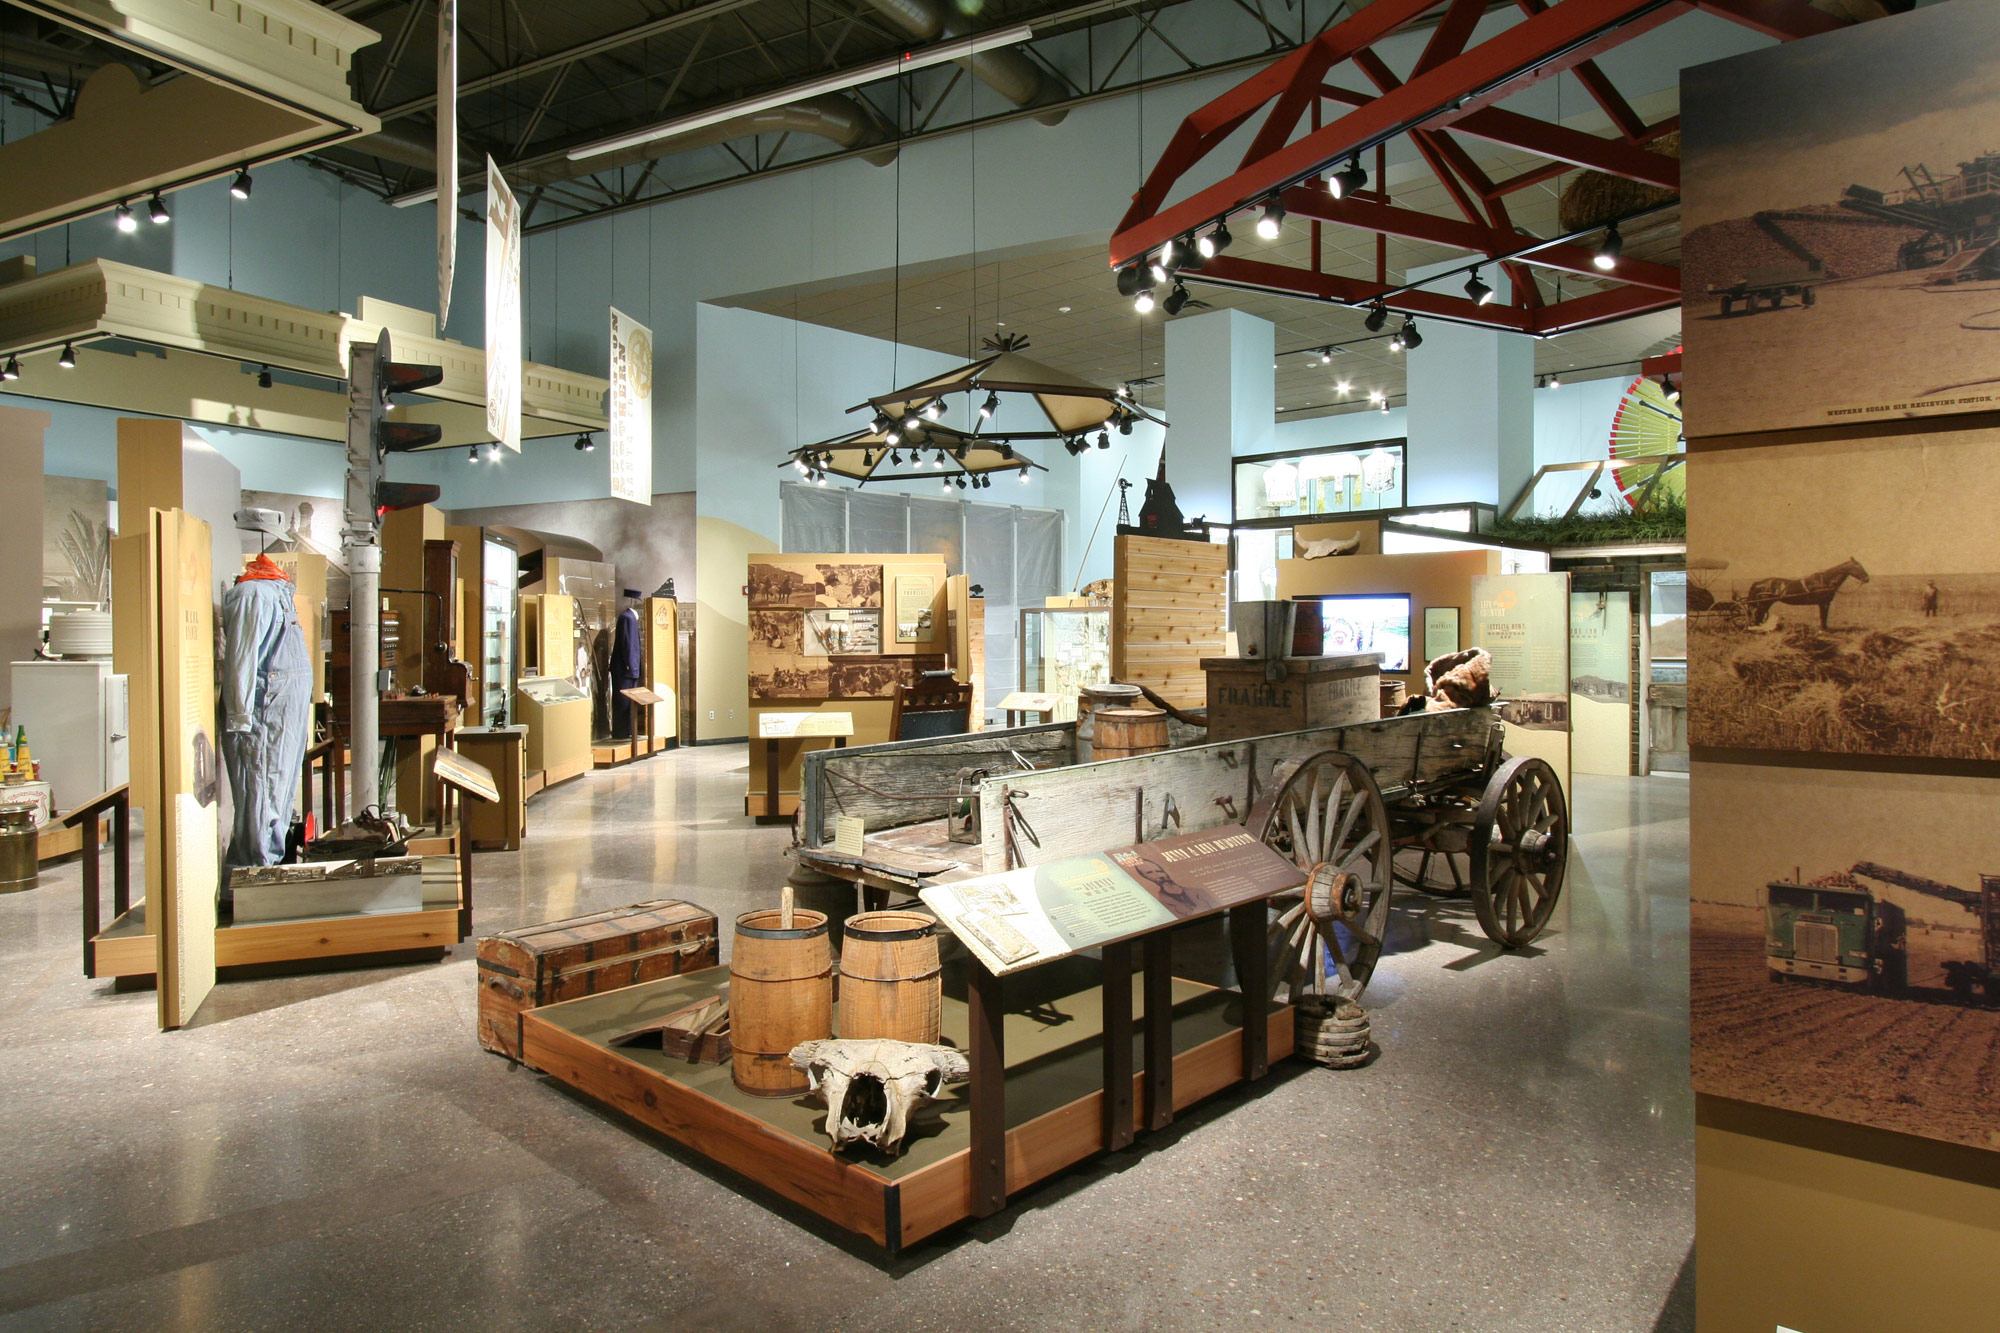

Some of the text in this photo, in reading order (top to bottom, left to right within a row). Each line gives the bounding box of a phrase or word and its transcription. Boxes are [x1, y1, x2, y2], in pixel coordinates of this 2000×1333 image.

[619, 342, 627, 494] NORTHERN
[1827, 408, 1863, 416] WESTERN
[1218, 686, 1293, 708] FRAGILE
[1328, 679, 1362, 701] FRAGILE
